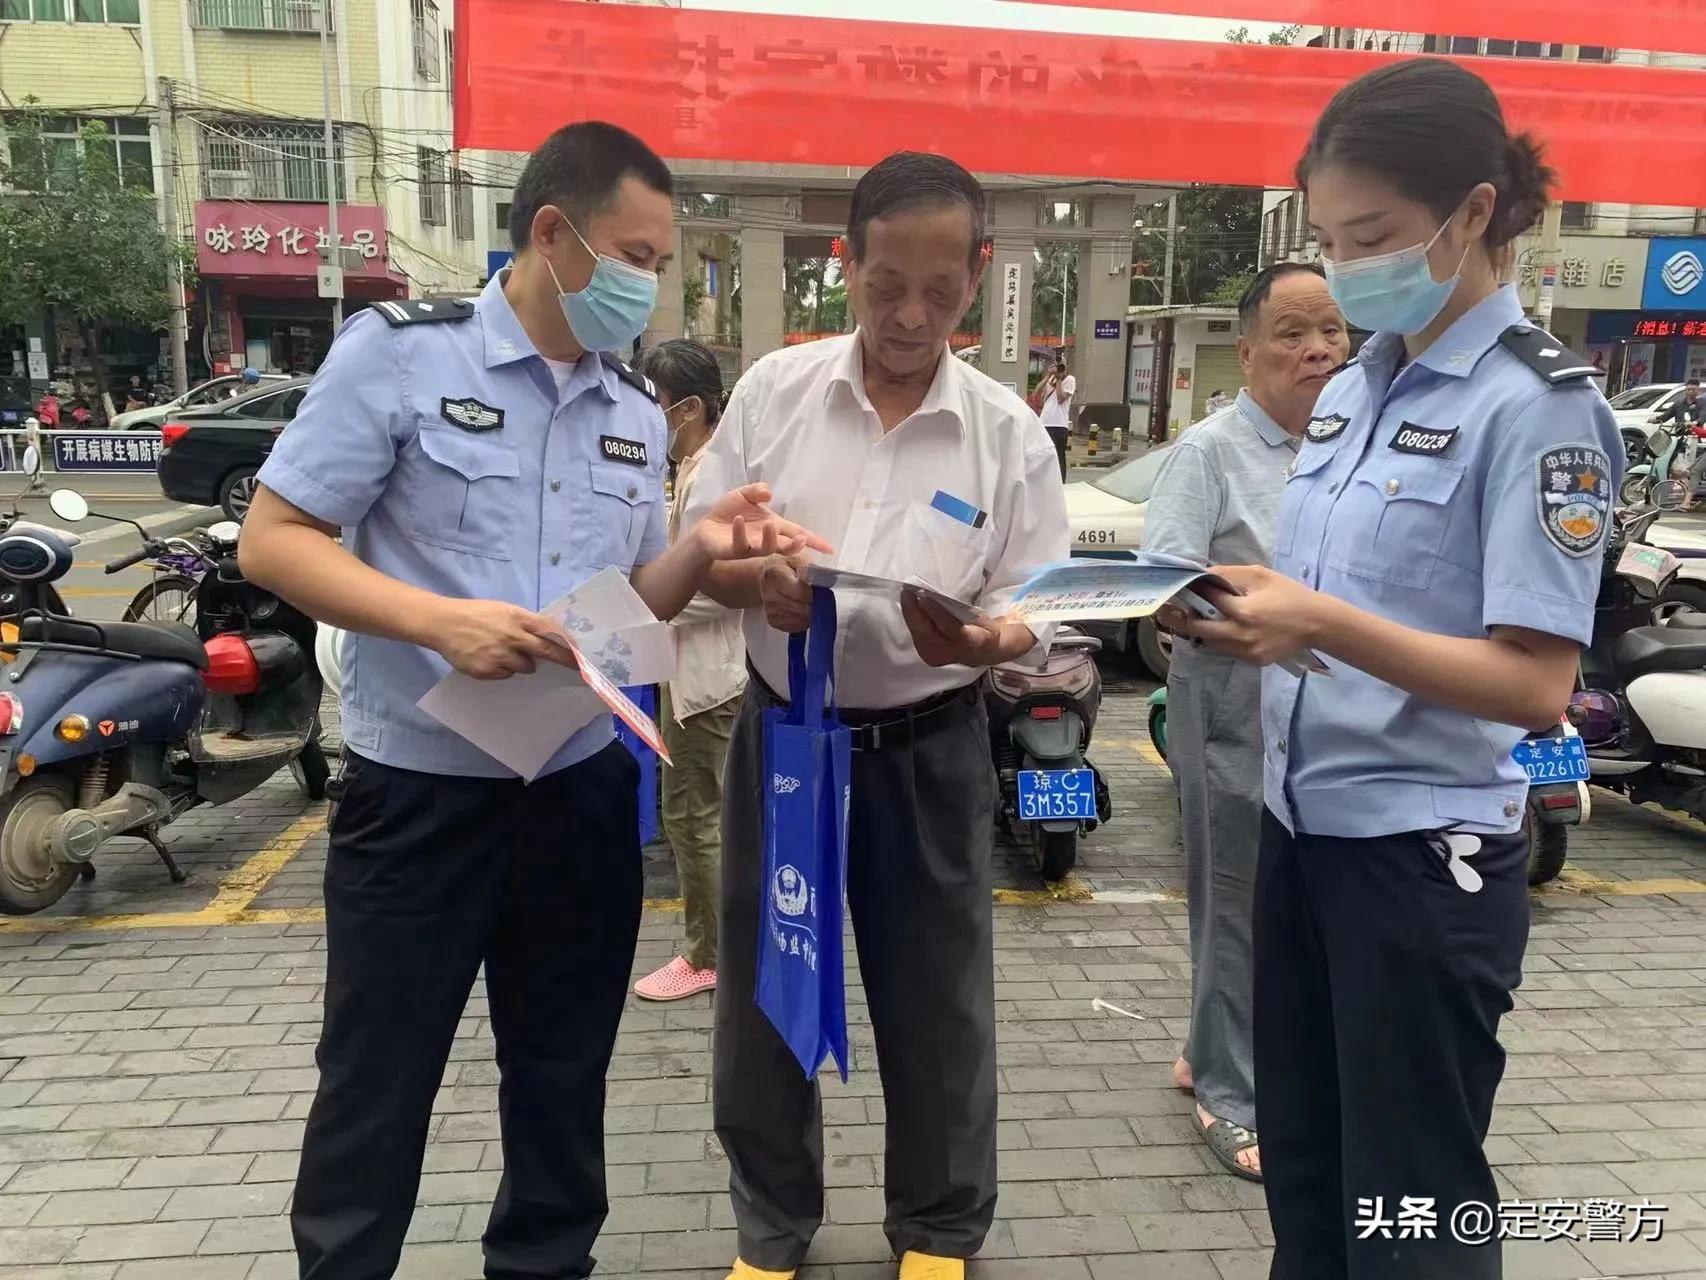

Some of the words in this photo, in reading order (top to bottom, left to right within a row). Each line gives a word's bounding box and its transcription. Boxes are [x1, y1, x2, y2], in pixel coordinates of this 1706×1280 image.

[605, 440, 646, 461] 080294
[1078, 530, 1115, 543] 4691
[1526, 758, 1587, 778] 022610
[1024, 792, 1091, 816] 3M357
